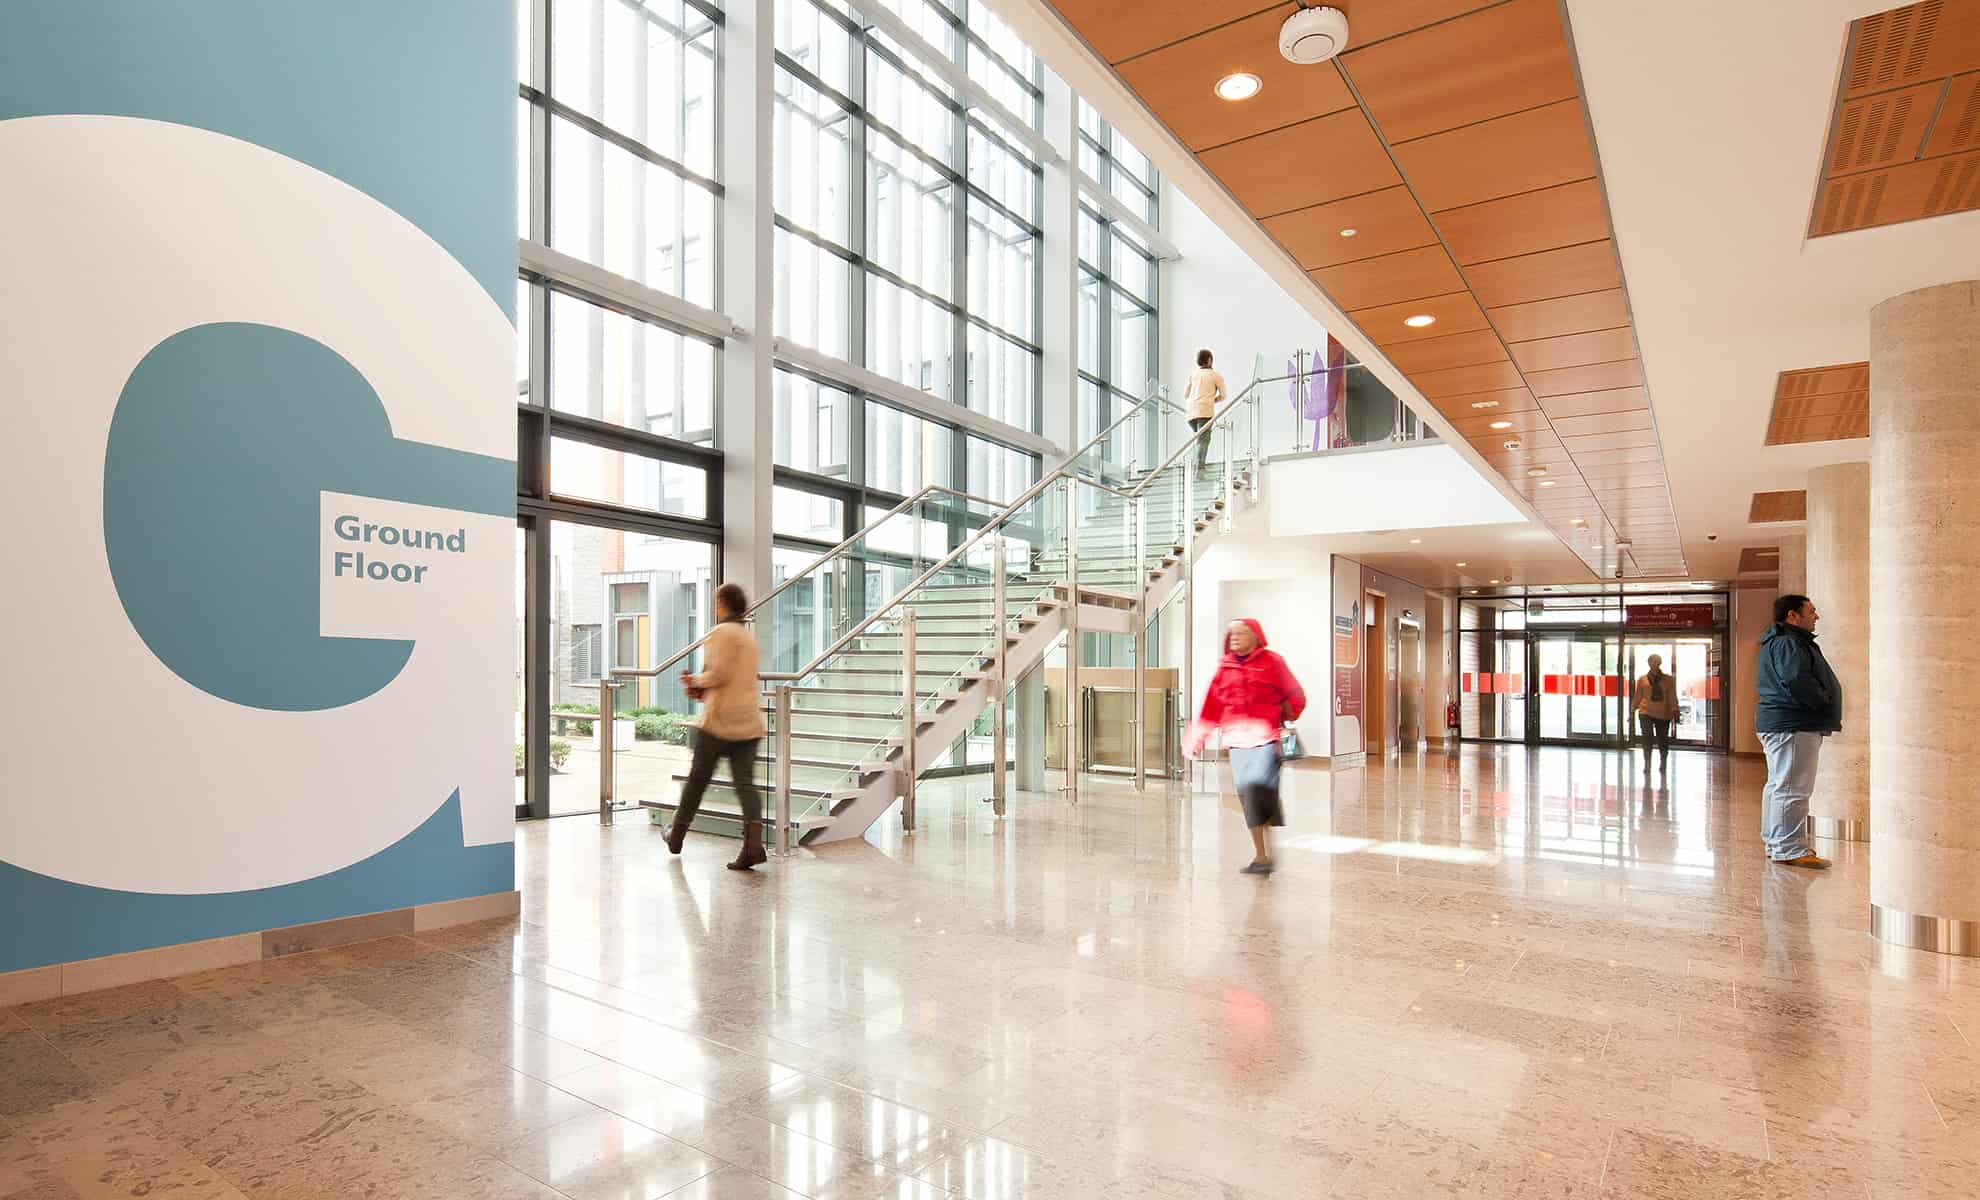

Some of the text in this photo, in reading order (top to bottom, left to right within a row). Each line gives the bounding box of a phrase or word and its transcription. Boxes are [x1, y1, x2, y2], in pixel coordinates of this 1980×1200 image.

[0, 114, 518, 895] G
[334, 515, 465, 552] Ground
[334, 552, 428, 583] Floor
